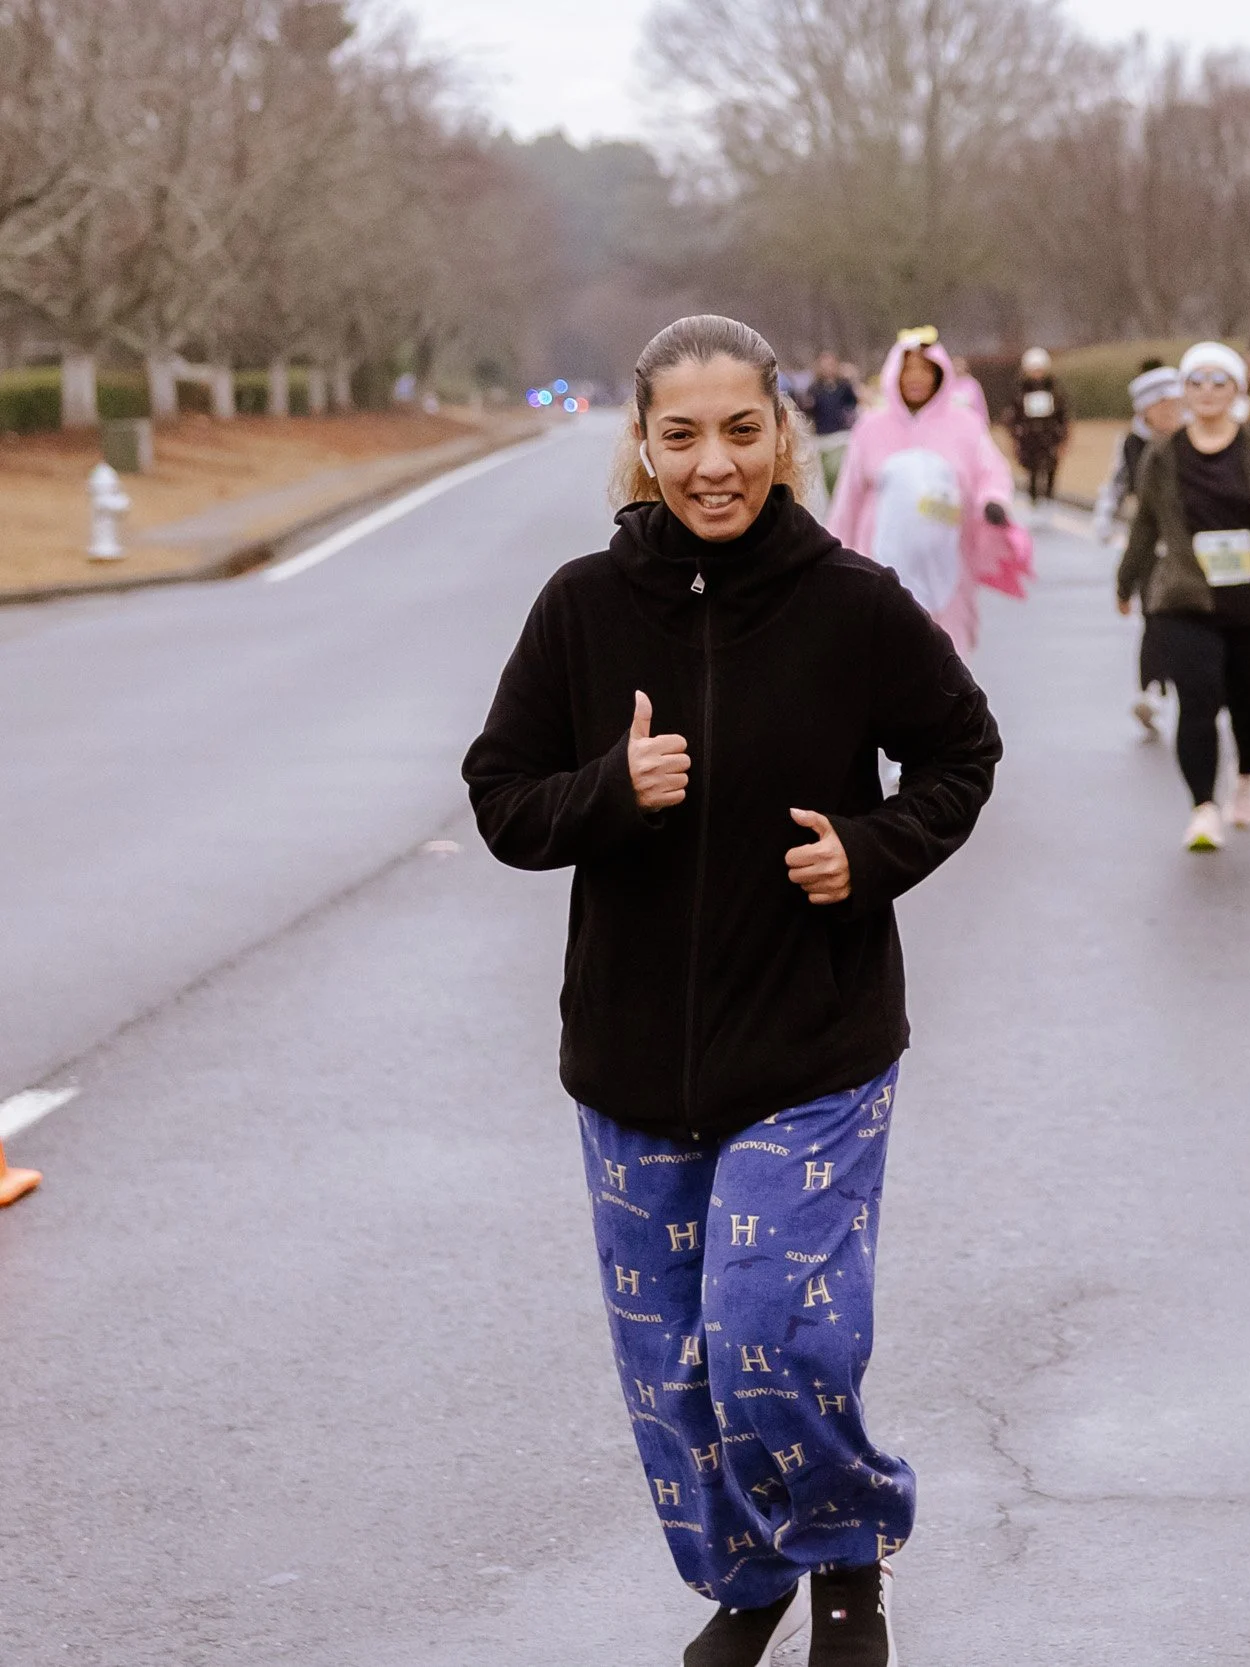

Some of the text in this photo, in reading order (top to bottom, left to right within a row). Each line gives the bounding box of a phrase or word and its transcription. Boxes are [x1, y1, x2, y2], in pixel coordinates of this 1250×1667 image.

[638, 1151, 703, 1166] HOGWARTS
[729, 1140, 791, 1158] HOGWARTS
[604, 1158, 627, 1193] H
[803, 1161, 835, 1190] H
[665, 1221, 700, 1252] H
[730, 1214, 760, 1247] H
[784, 1250, 831, 1264] WARTS
[614, 1264, 641, 1297] H
[803, 1274, 834, 1308] H
[610, 1303, 663, 1323] HOGWA
[678, 1335, 703, 1367] H
[737, 1344, 772, 1372] H
[634, 1378, 657, 1409] H
[733, 1387, 799, 1400] HOGWARTS
[816, 1394, 848, 1417] H
[691, 1441, 721, 1473] H
[772, 1442, 809, 1474] H
[653, 1478, 682, 1507] H
[727, 1530, 756, 1554] H
